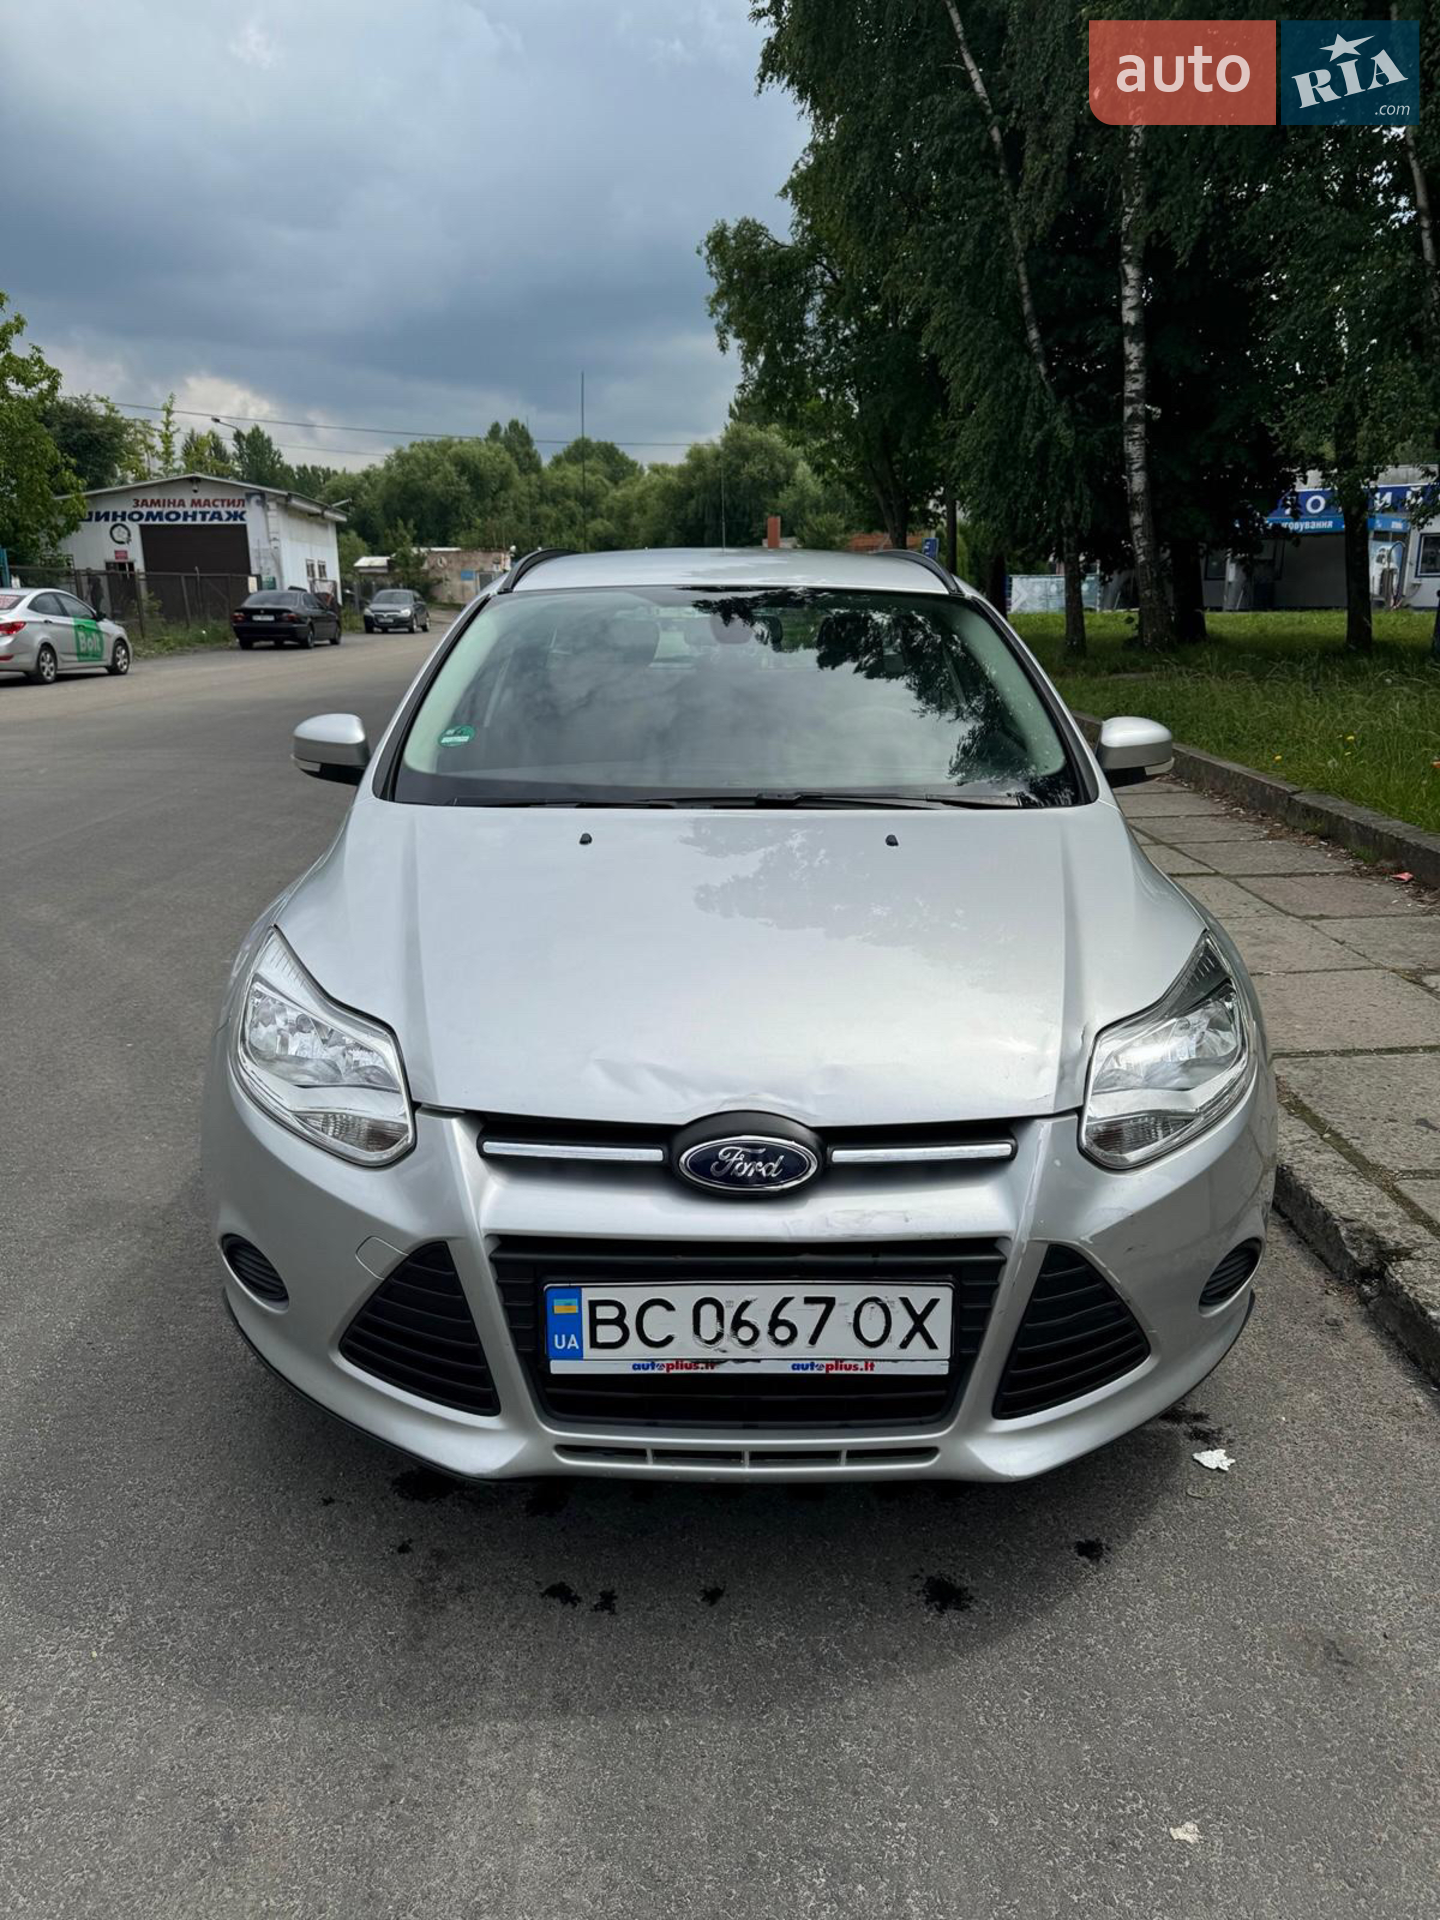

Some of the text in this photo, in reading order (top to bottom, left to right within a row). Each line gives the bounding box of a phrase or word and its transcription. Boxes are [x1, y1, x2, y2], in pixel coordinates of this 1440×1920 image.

[132, 498, 246, 509] ЗАМІНА МАСТИЛ
[710, 1146, 784, 1178] Ford
[692, 1295, 837, 1349] 0667
[554, 1333, 580, 1351] UA
[791, 1359, 876, 1373] autoplius.lt
